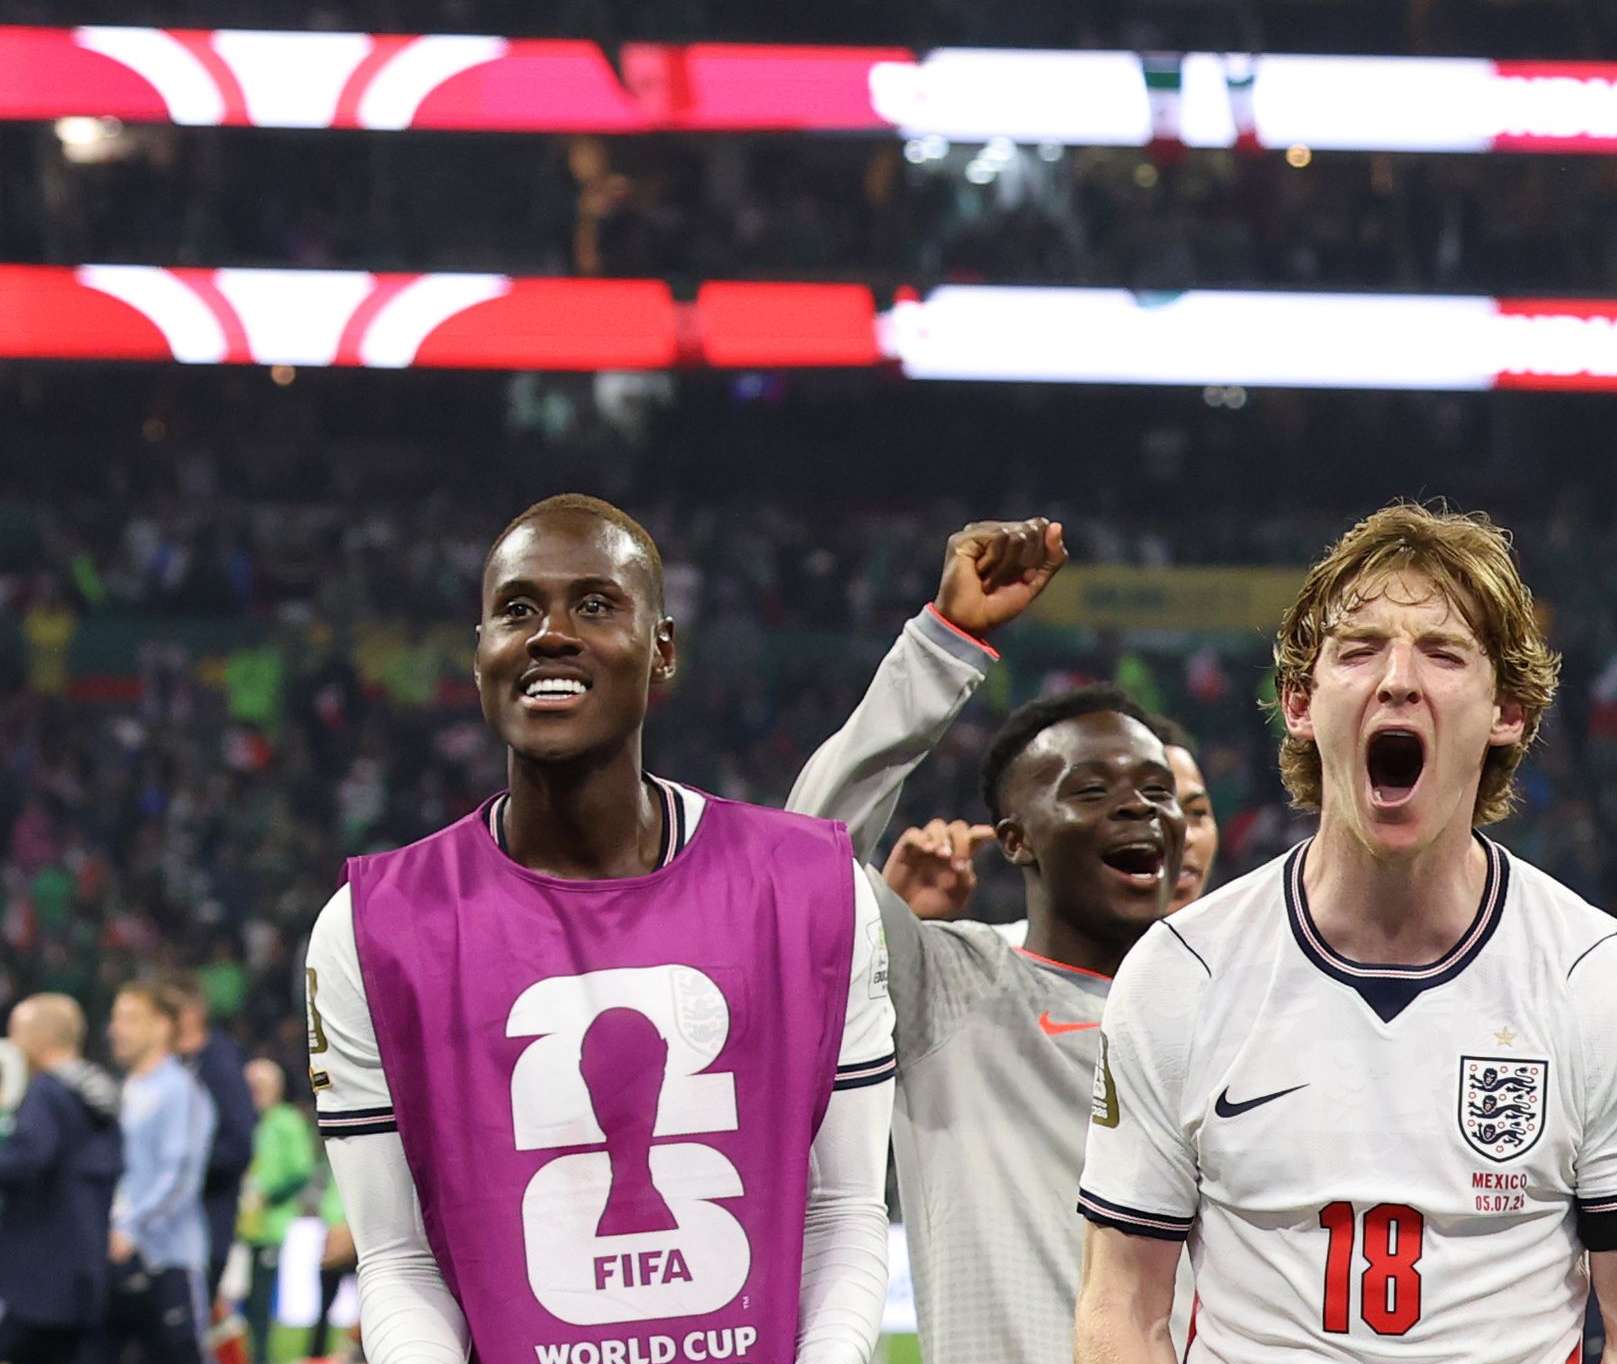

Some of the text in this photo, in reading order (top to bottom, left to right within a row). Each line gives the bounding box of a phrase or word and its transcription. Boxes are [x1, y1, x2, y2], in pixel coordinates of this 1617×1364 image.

[1471, 1171, 1528, 1190] MEXICO
[593, 1248, 693, 1290] FIFA
[1318, 1200, 1424, 1336] 18
[683, 1325, 757, 1361] CUP
